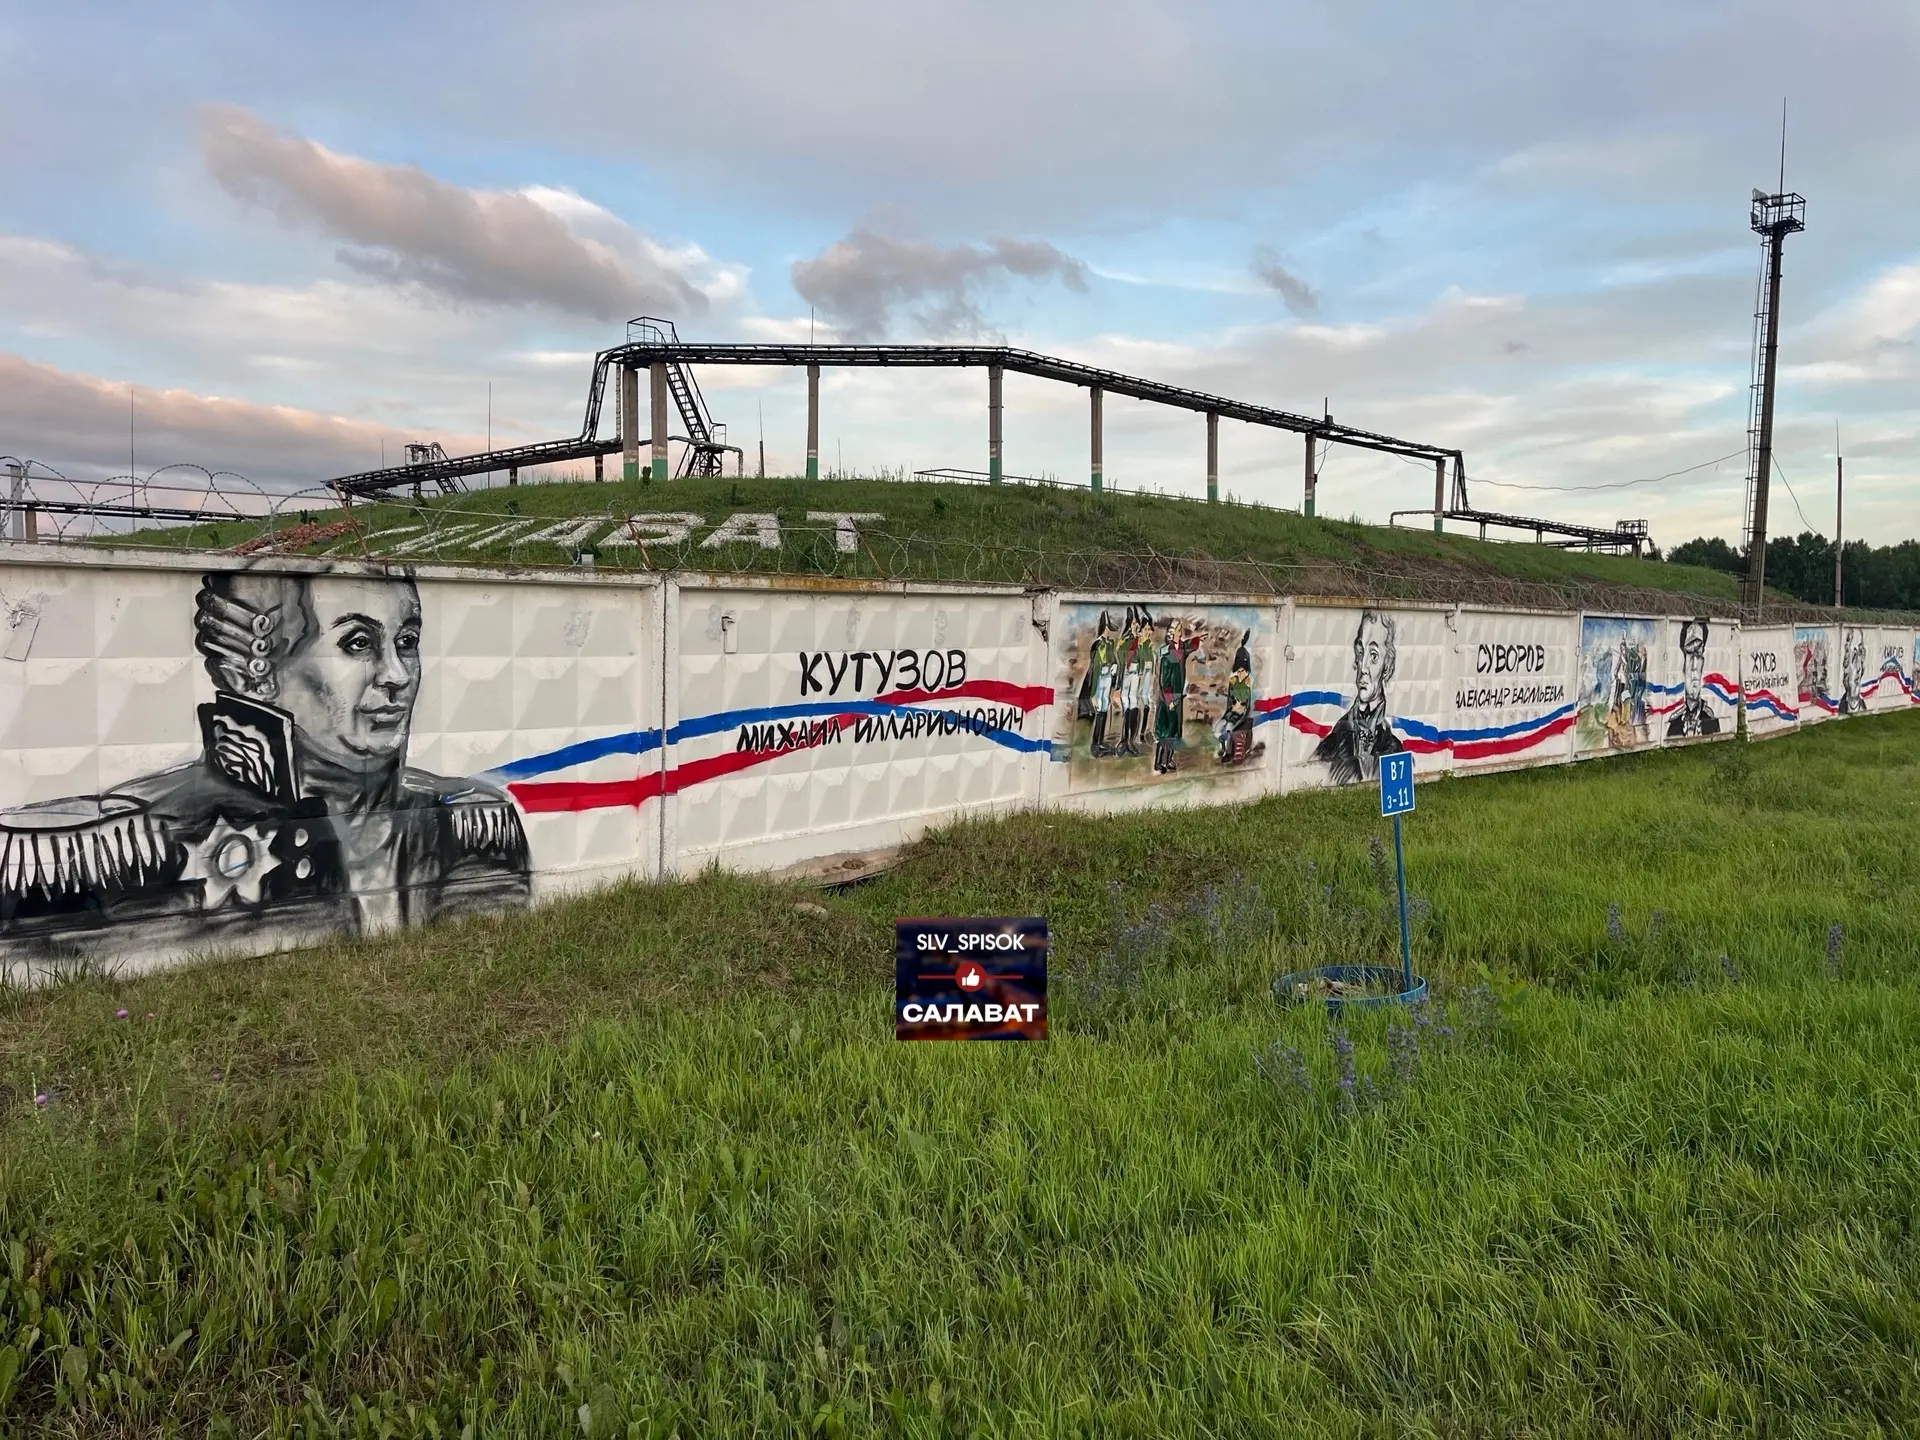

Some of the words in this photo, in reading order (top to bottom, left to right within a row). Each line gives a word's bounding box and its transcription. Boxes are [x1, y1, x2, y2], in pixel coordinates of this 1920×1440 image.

[799, 649, 967, 696] КУТУЗОВ
[1476, 644, 1545, 673] СУВОРОВ
[1456, 687, 1510, 709] АЛЕКСАНДР
[736, 719, 841, 753] МИХАИЛ
[854, 708, 1025, 743] ИЛЛАРИОНОВИЧ
[1387, 787, 1409, 809] 3-11
